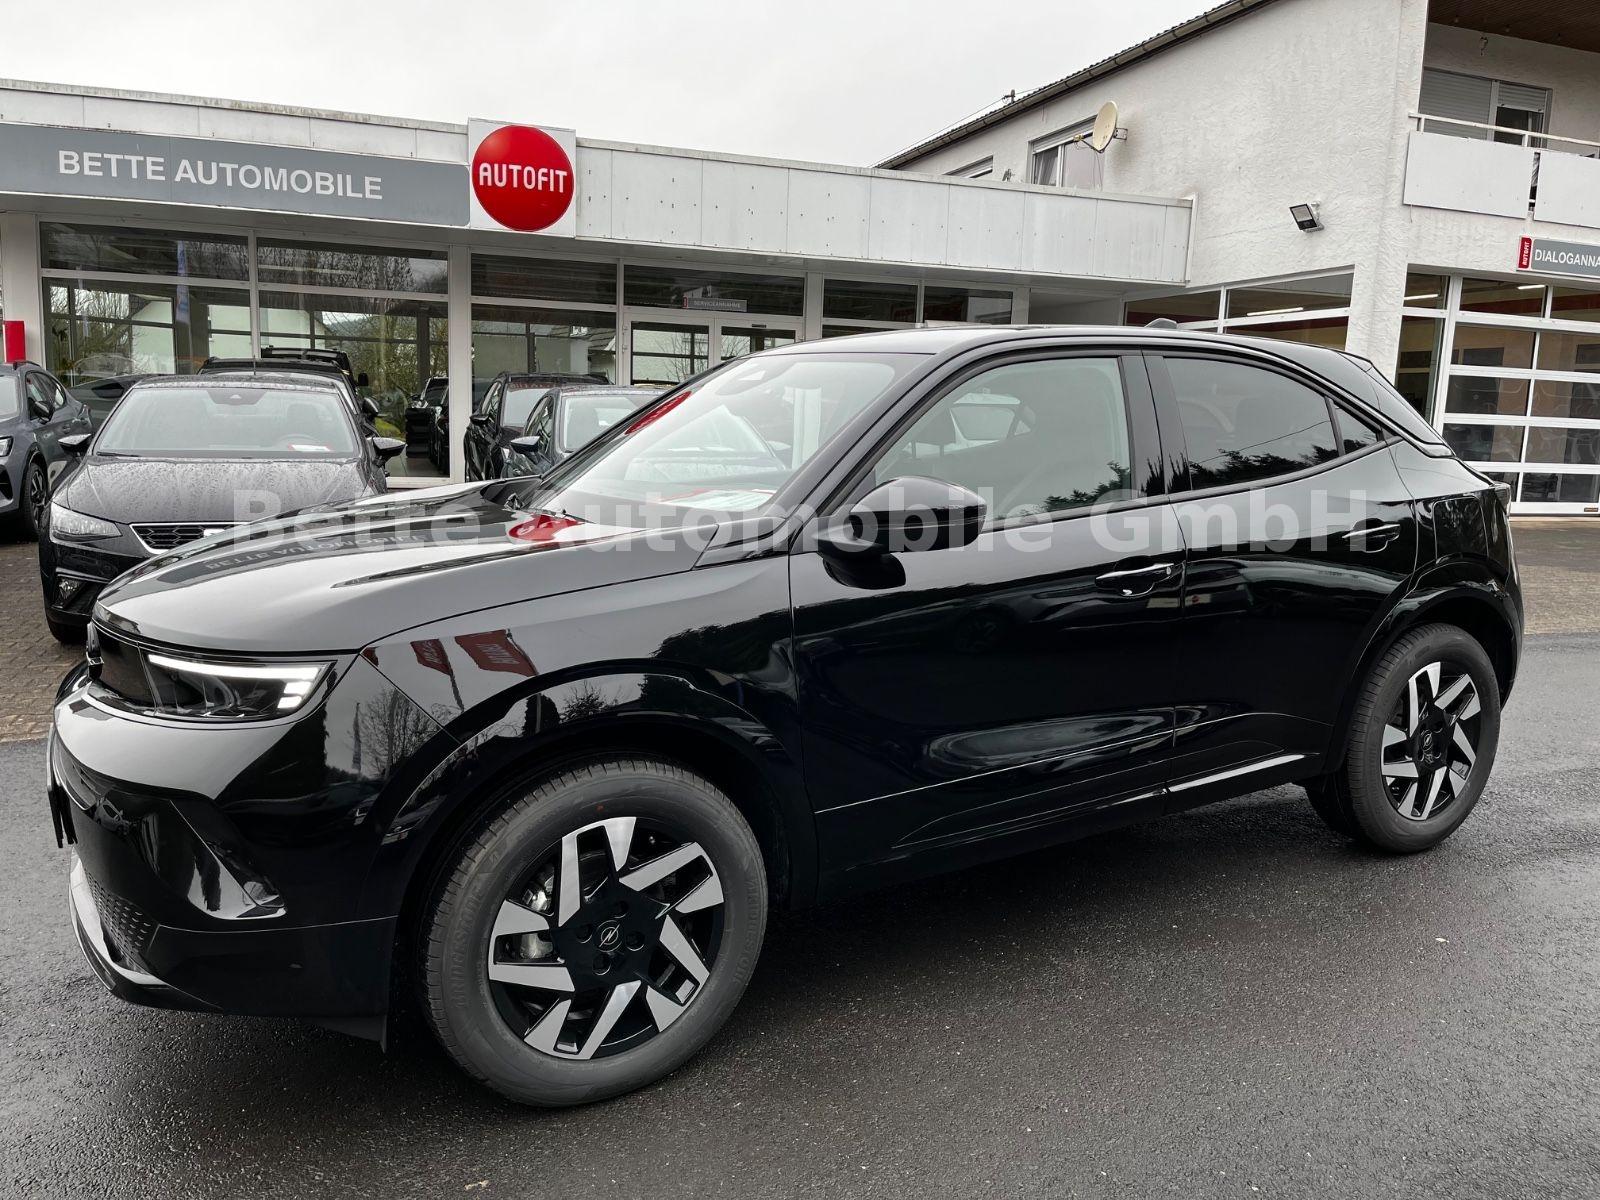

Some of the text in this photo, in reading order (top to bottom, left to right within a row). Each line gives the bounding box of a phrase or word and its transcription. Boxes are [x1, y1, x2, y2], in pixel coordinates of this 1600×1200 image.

[58, 149, 383, 200] BETTE AUTOMOBILE
[479, 162, 568, 193] AUTOFIT
